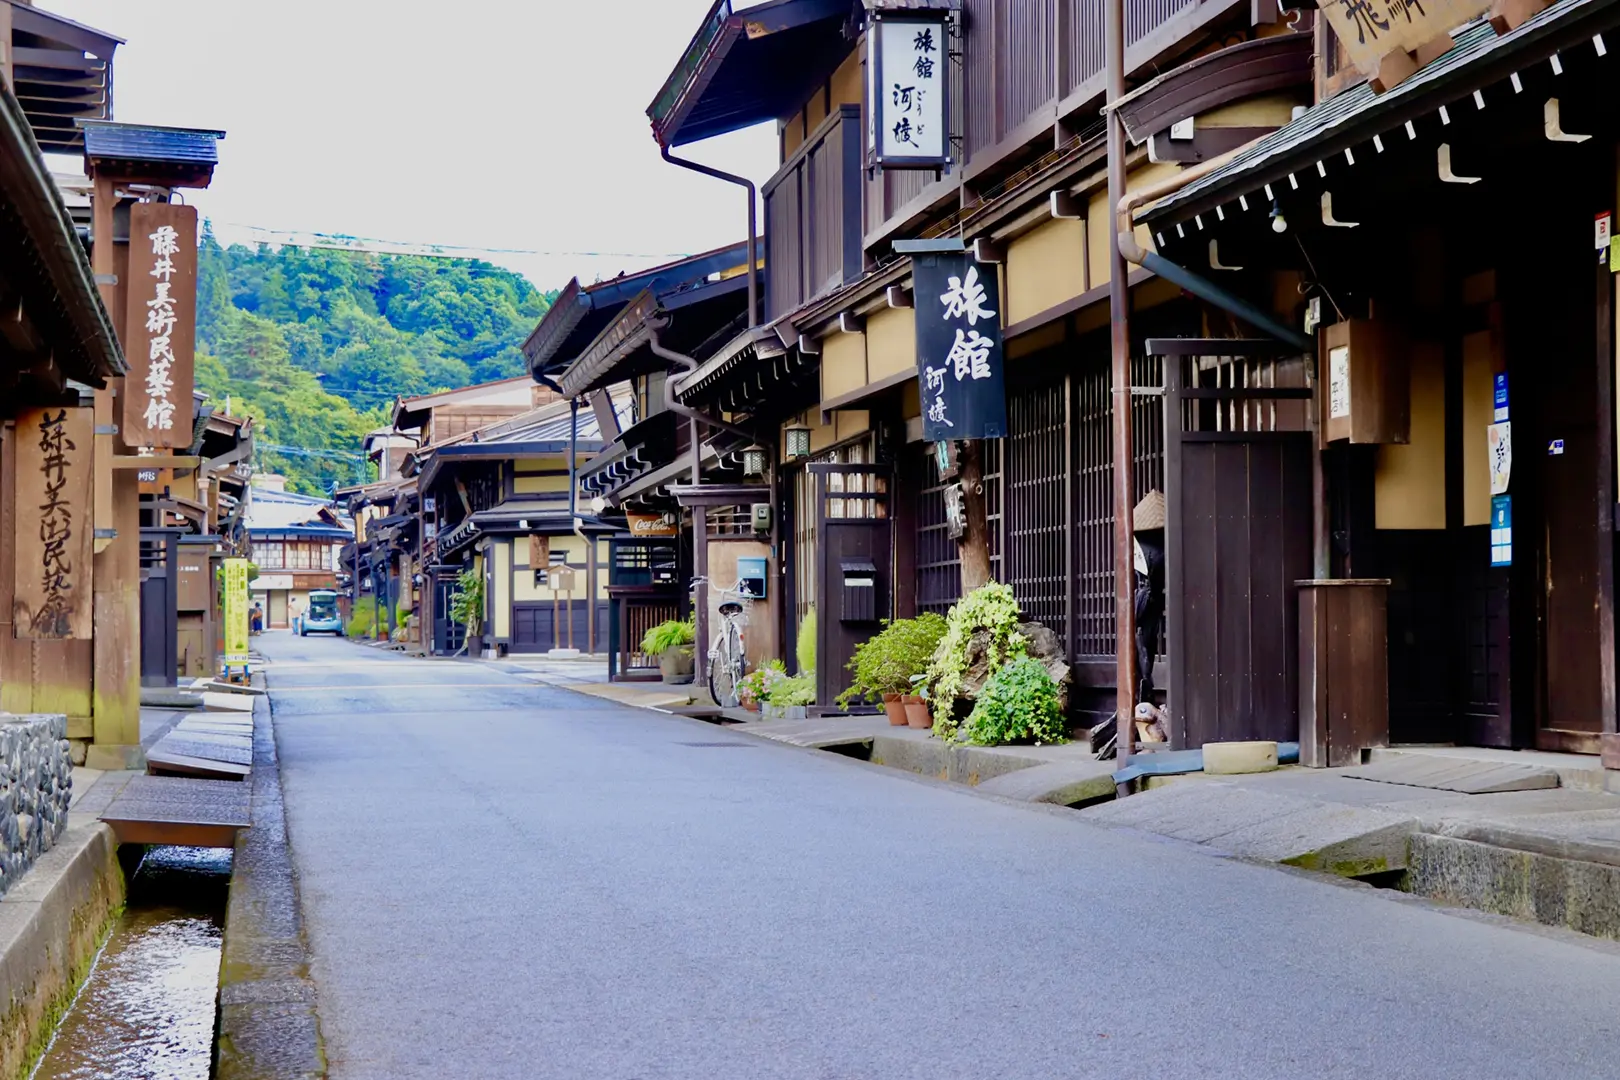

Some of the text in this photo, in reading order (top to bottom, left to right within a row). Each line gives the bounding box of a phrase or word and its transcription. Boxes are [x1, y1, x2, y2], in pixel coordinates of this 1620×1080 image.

[913, 28, 937, 79] 旅館
[143, 225, 181, 431] 藤井美術民藝館
[940, 266, 997, 382] 旅館
